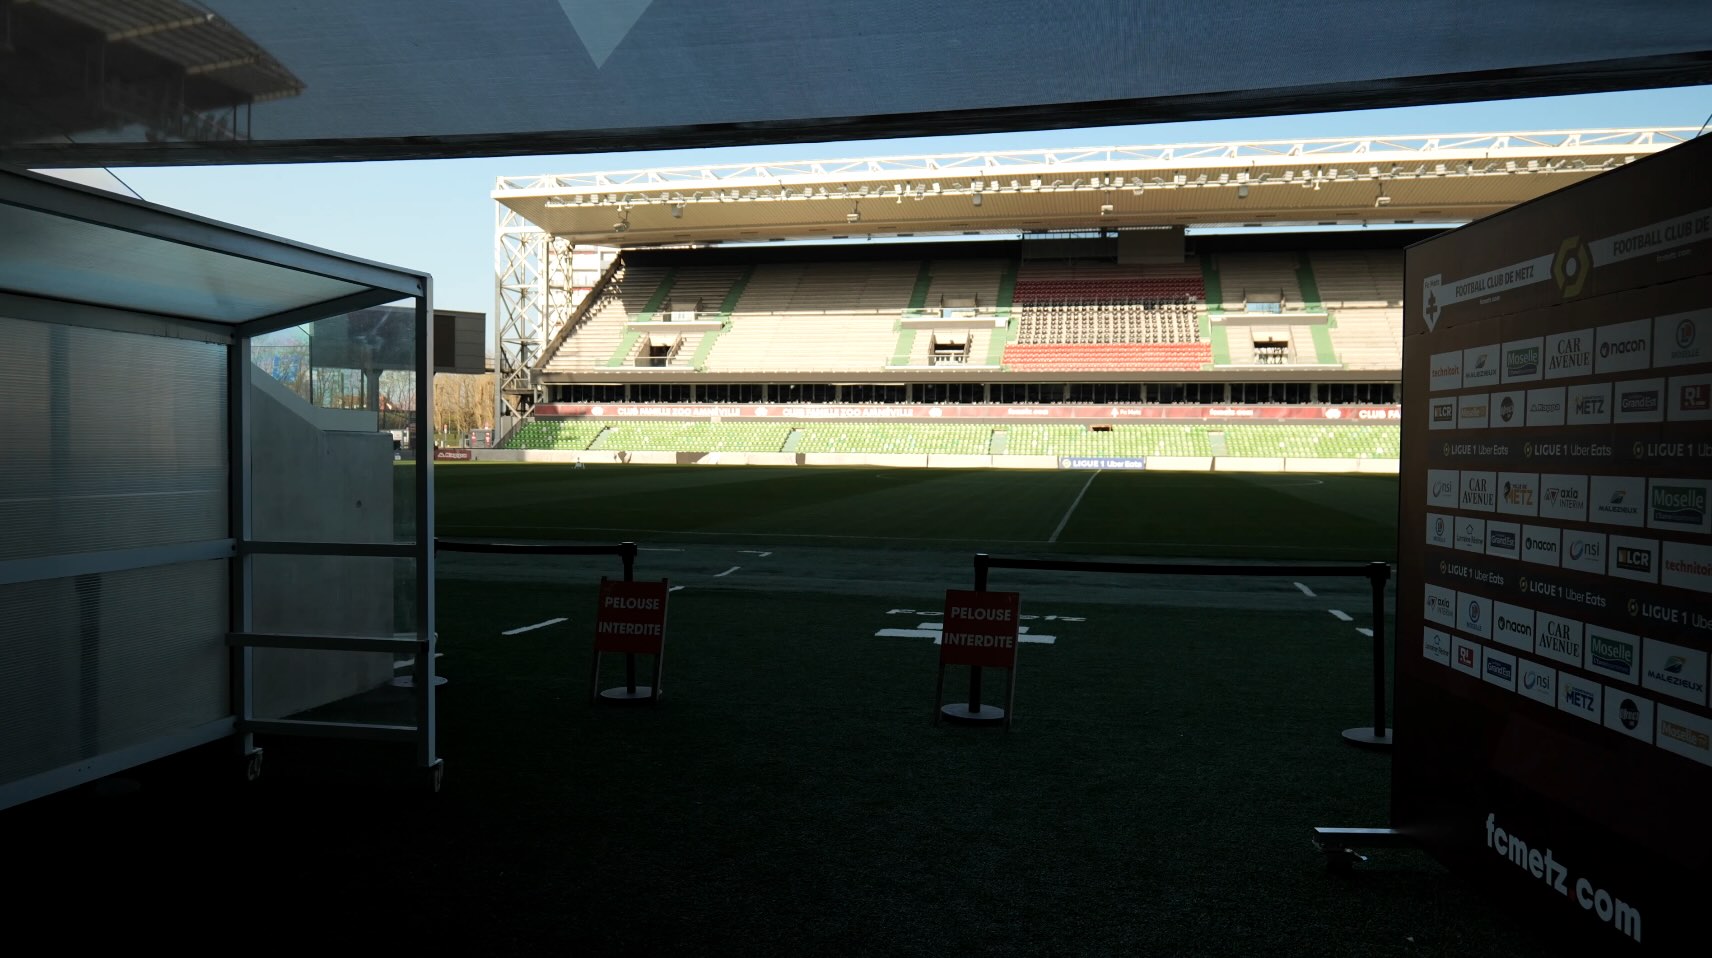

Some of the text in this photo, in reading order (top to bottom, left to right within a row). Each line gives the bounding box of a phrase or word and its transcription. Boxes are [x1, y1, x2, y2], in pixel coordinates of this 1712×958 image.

[1614, 230, 1662, 256] FOOTBALL
[1664, 221, 1692, 240] CLUB
[1695, 216, 1710, 234] DE
[1456, 266, 1534, 298] FOOTBALL CLUB DE METZ
[1558, 338, 1581, 355] CAR
[1610, 339, 1646, 356] nacon
[1509, 350, 1538, 365] Moselle
[1549, 352, 1590, 370] AVENUE
[1358, 410, 1386, 419] CLUB
[1576, 400, 1604, 416] METZ
[1451, 444, 1509, 456] LIGUE 1 Uber Eats
[1534, 443, 1612, 456] LIGUE 1 Uber Eats
[1647, 443, 1684, 457] LIGUE
[1687, 443, 1694, 457] 1
[1469, 478, 1488, 492] CAR
[1560, 488, 1578, 499] axia
[1462, 491, 1494, 506] AVENUE
[1654, 489, 1704, 509] Moselle
[1531, 540, 1557, 552] nacon
[1584, 542, 1600, 557] nsi
[1627, 550, 1649, 567] LCR
[1448, 563, 1504, 586] LIGUE 1 Uber Eats
[604, 596, 660, 610] PELOUSE
[1530, 581, 1606, 608] LIGUE 1 Uber Eats
[950, 606, 1012, 622] PELOUSE
[1642, 602, 1679, 623] LIGUE
[1681, 610, 1688, 625] 1
[598, 622, 661, 636] INTERDITE
[1506, 618, 1532, 636] nacon
[1548, 621, 1570, 640] CAR
[944, 632, 1014, 648] INTERDITE
[1540, 634, 1580, 658] AVENUE
[1592, 636, 1632, 660] Moselle
[1536, 676, 1550, 690] nsi
[1648, 670, 1704, 692] MALEZIEUX
[1566, 690, 1594, 712] METZ
[1486, 812, 1642, 944] fcmetz.com
